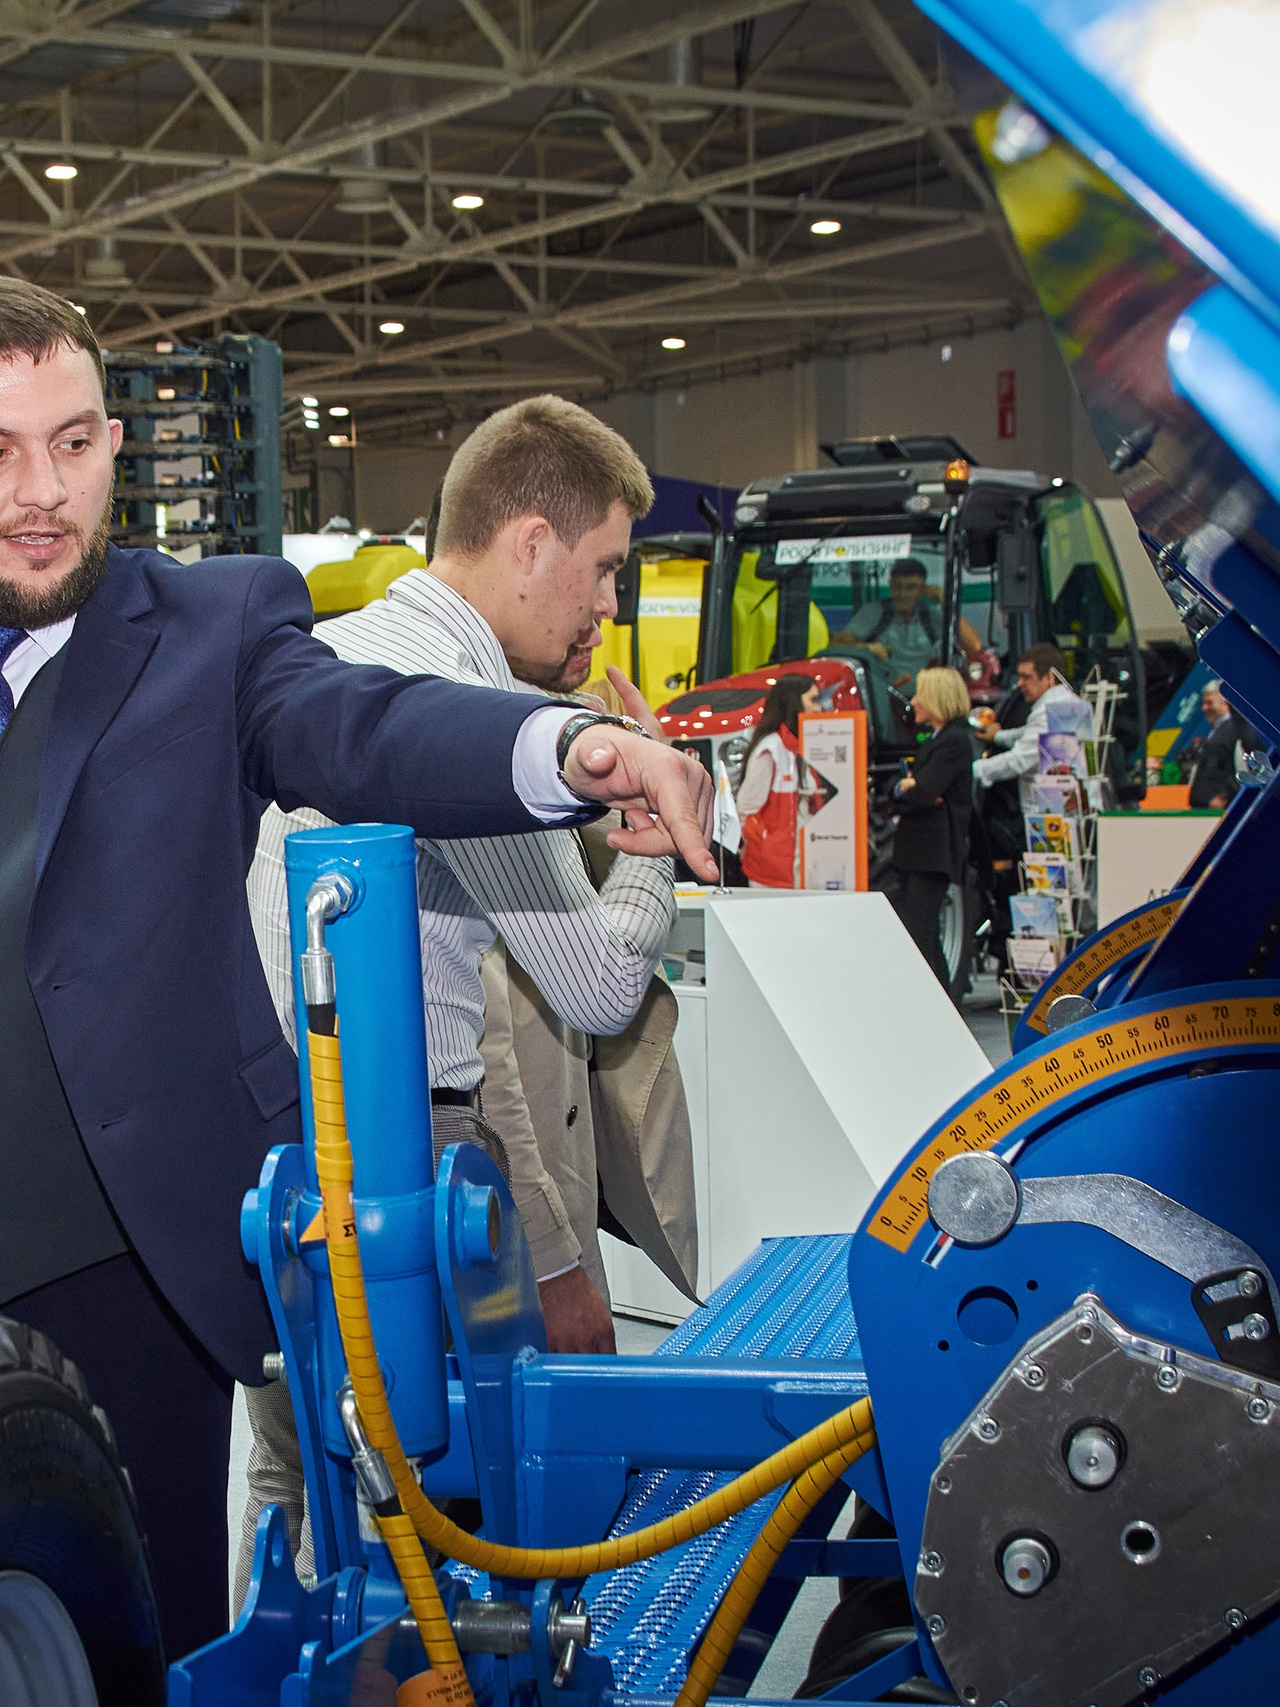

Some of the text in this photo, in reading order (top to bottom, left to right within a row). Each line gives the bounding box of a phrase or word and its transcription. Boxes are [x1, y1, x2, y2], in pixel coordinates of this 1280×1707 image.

[1052, 985, 1063, 996] 10
[1076, 960, 1086, 972] 20
[1101, 939, 1113, 951] 30
[1130, 921, 1142, 932] 40
[1161, 906, 1173, 917] 50
[880, 1003, 1280, 1227] 0 5 10 15 20 25 30 35 40 45 50 55 60 65 70 75 8
